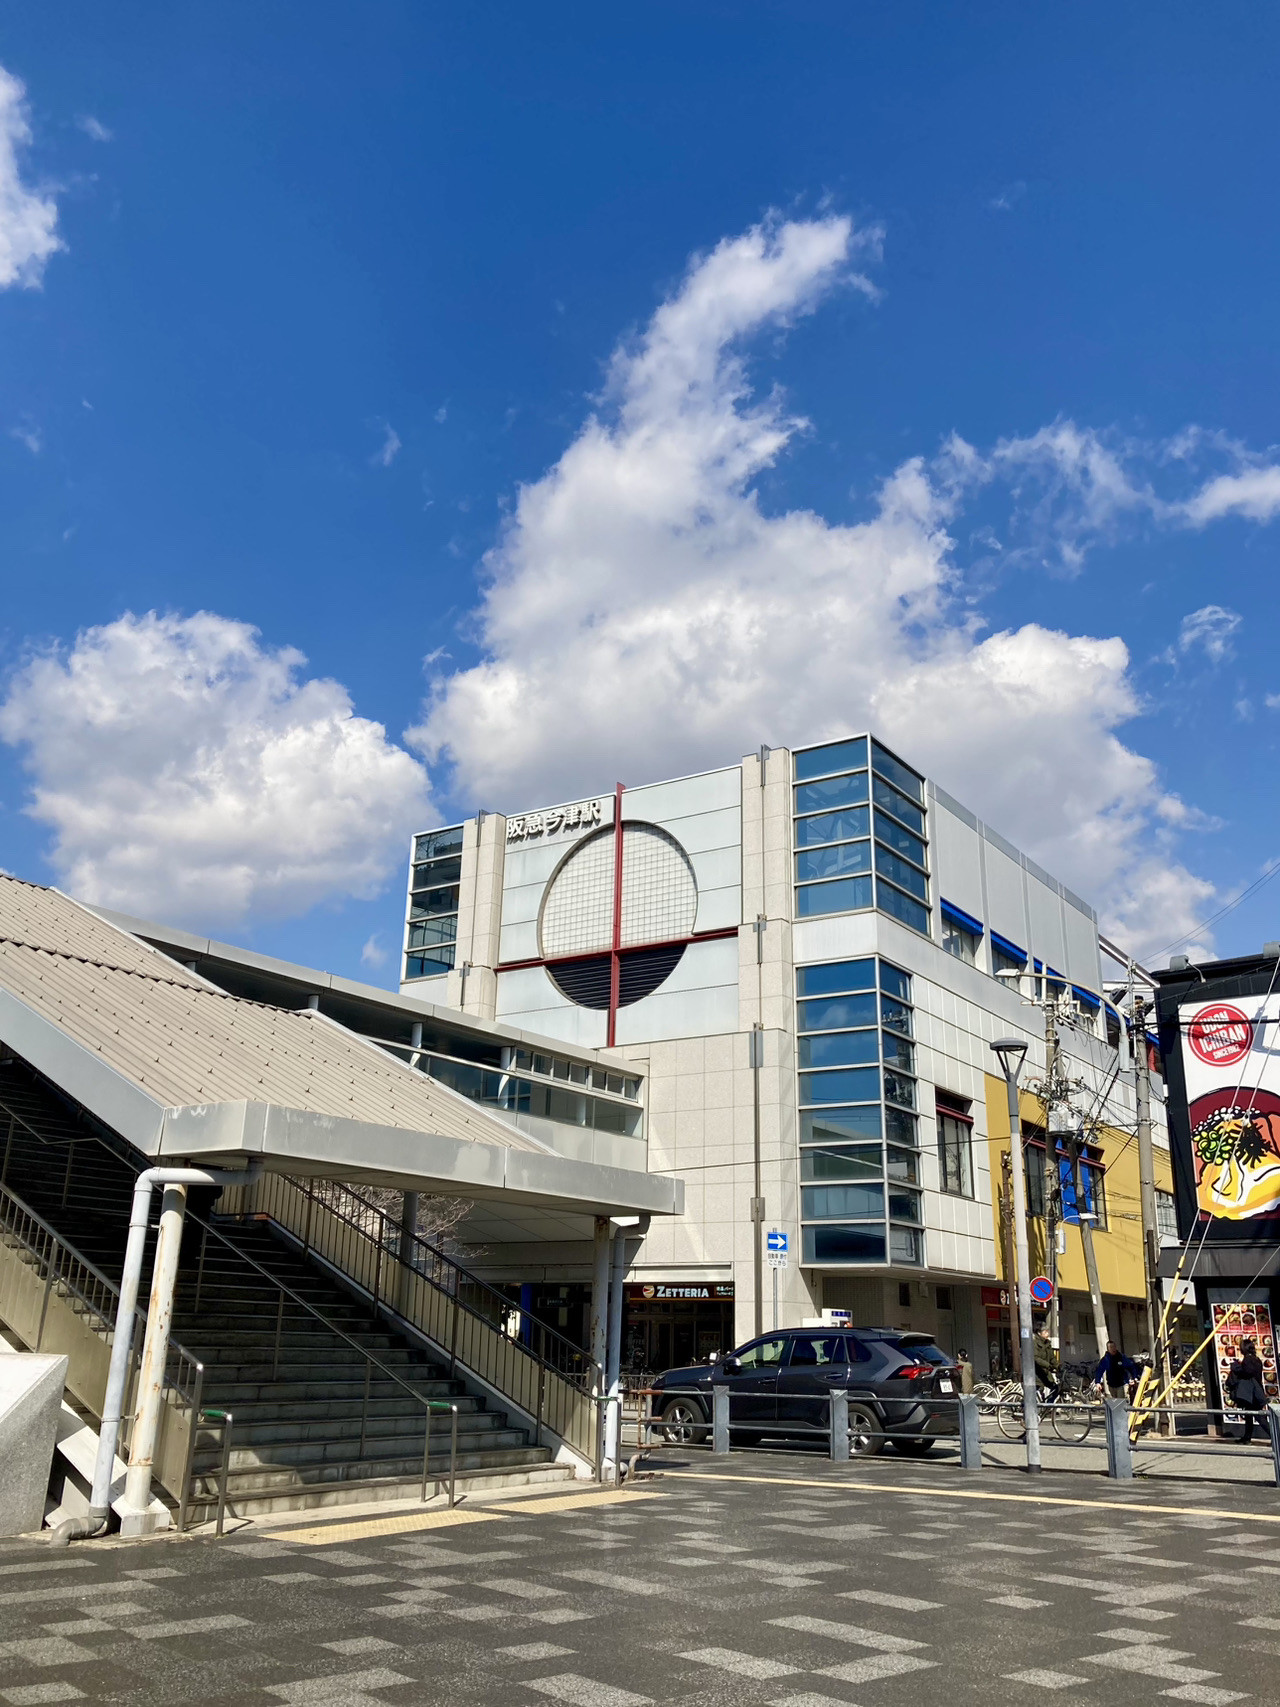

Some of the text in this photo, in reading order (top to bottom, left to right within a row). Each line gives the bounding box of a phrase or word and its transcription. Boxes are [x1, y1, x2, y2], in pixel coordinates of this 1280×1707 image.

[506, 800, 601, 838] 阪急今津駅
[1199, 1023, 1247, 1054] ICHIBAN
[656, 1285, 709, 1298] ZETTERIA
